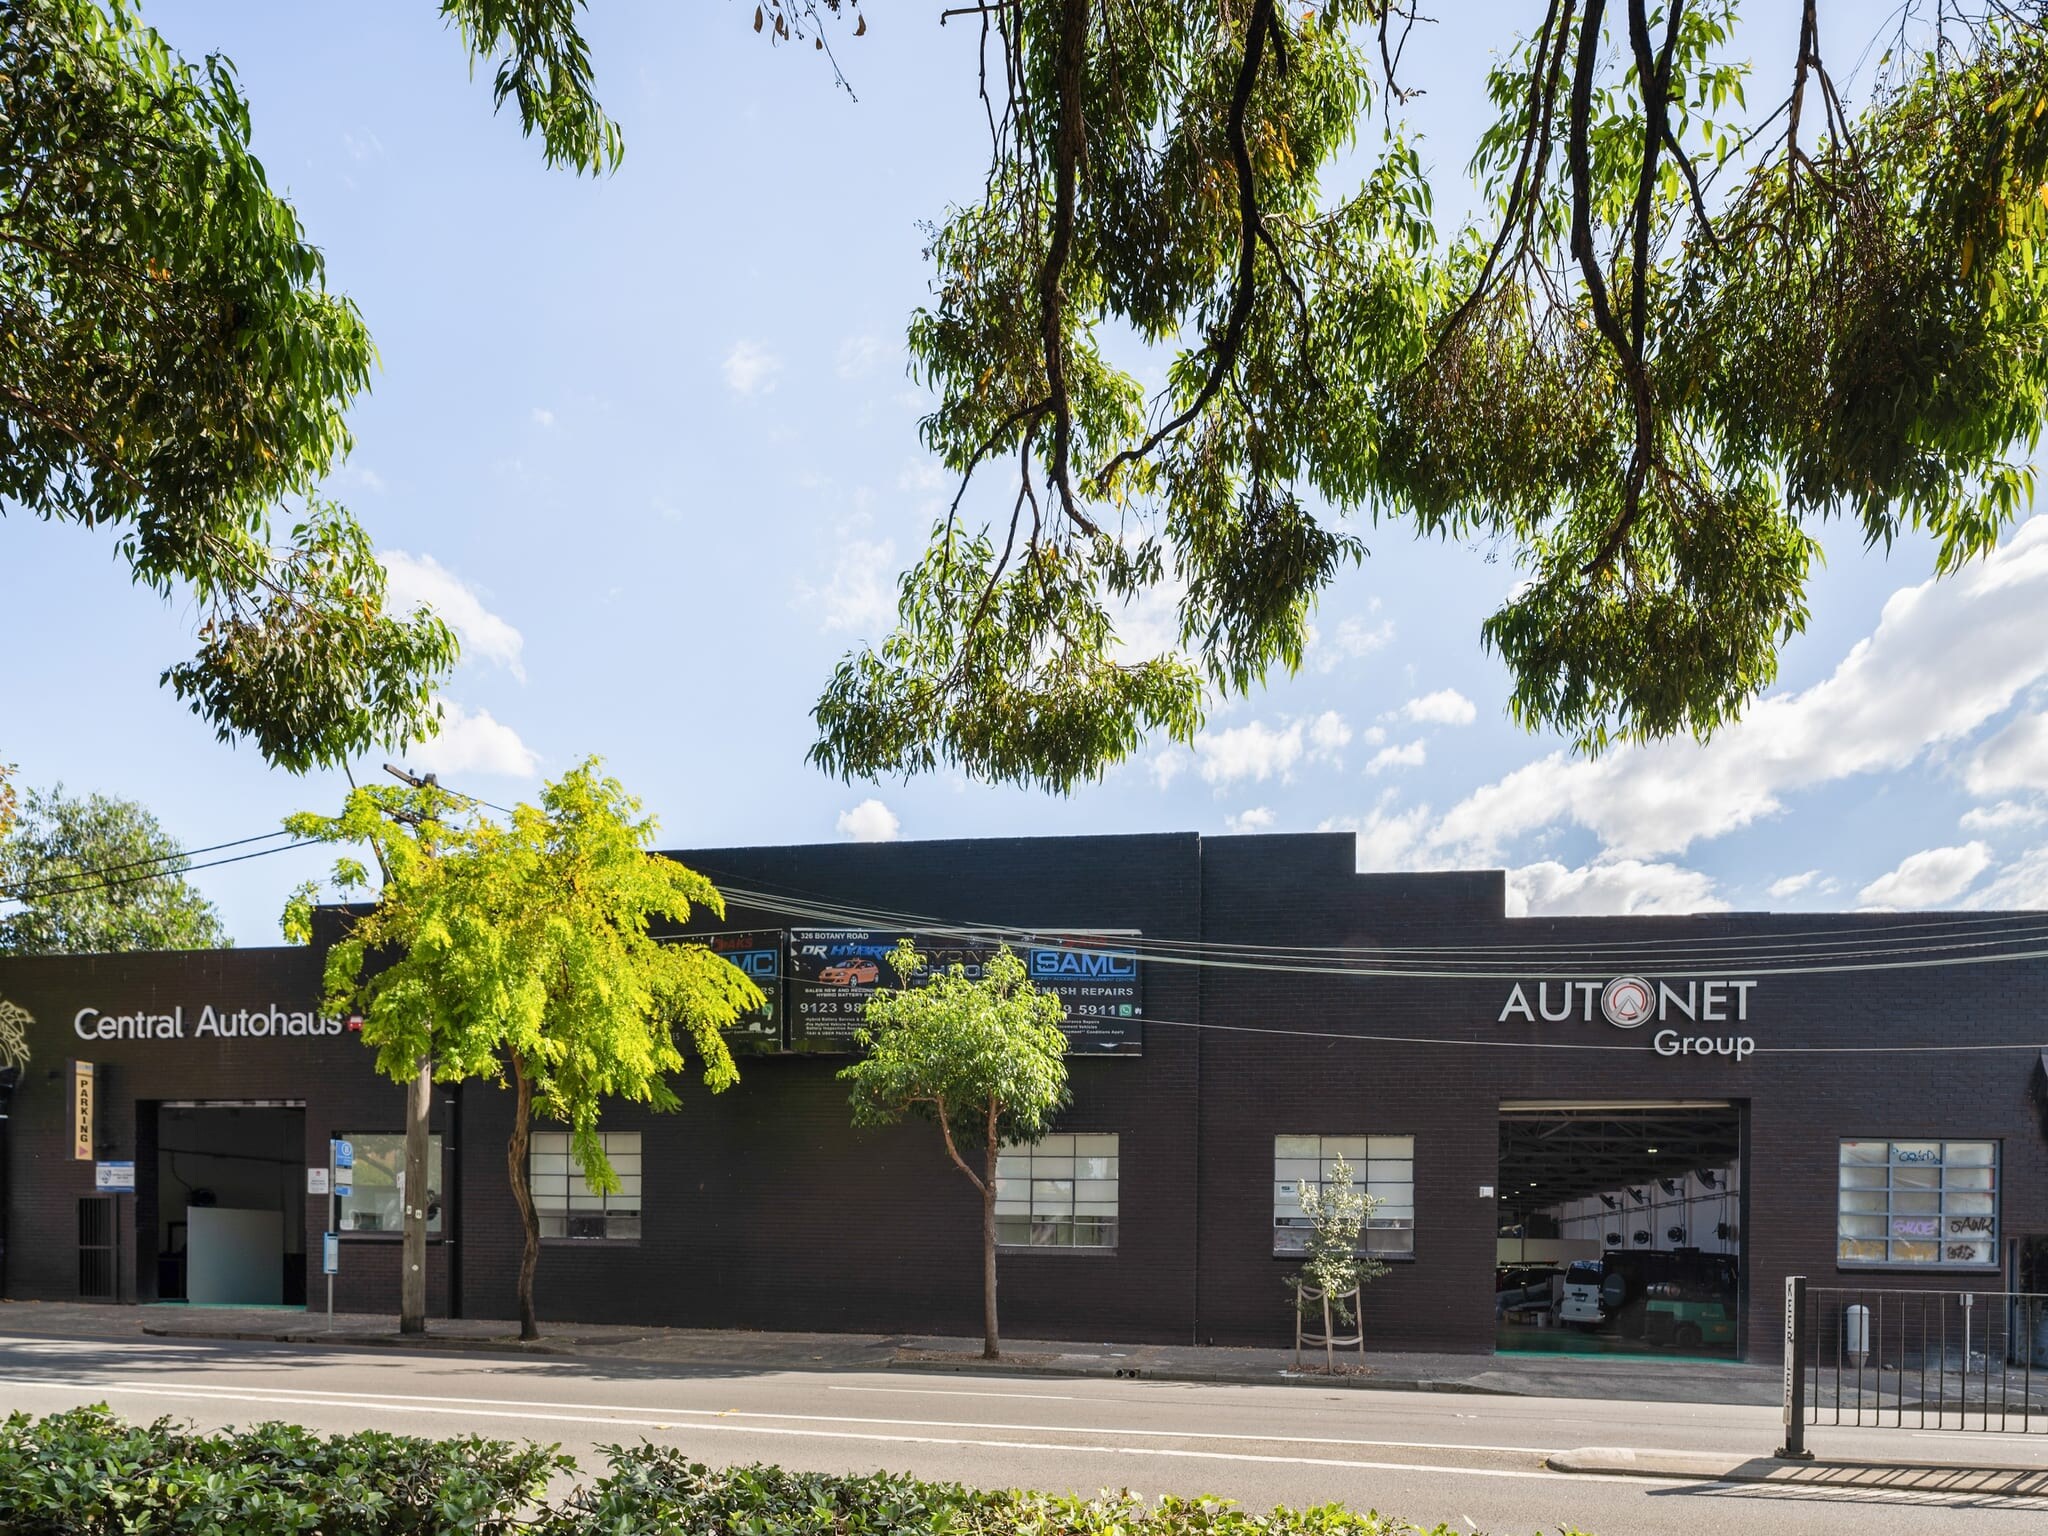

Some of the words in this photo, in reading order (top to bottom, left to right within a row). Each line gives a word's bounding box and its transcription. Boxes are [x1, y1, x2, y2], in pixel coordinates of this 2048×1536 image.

[801, 945, 828, 960] DR
[1036, 953, 1132, 976] SAMC
[1035, 987, 1076, 996] SMASH
[1081, 987, 1134, 996] REPAIRS
[1498, 975, 1758, 1028] AUTONET
[800, 1003, 838, 1013] 9123
[844, 1003, 862, 1013] 98
[1079, 1005, 1116, 1015] 5911
[74, 1006, 184, 1040] Central
[195, 1003, 343, 1038] Autohaus
[1653, 1029, 1755, 1062] Group
[80, 1080, 89, 1142] PARKING
